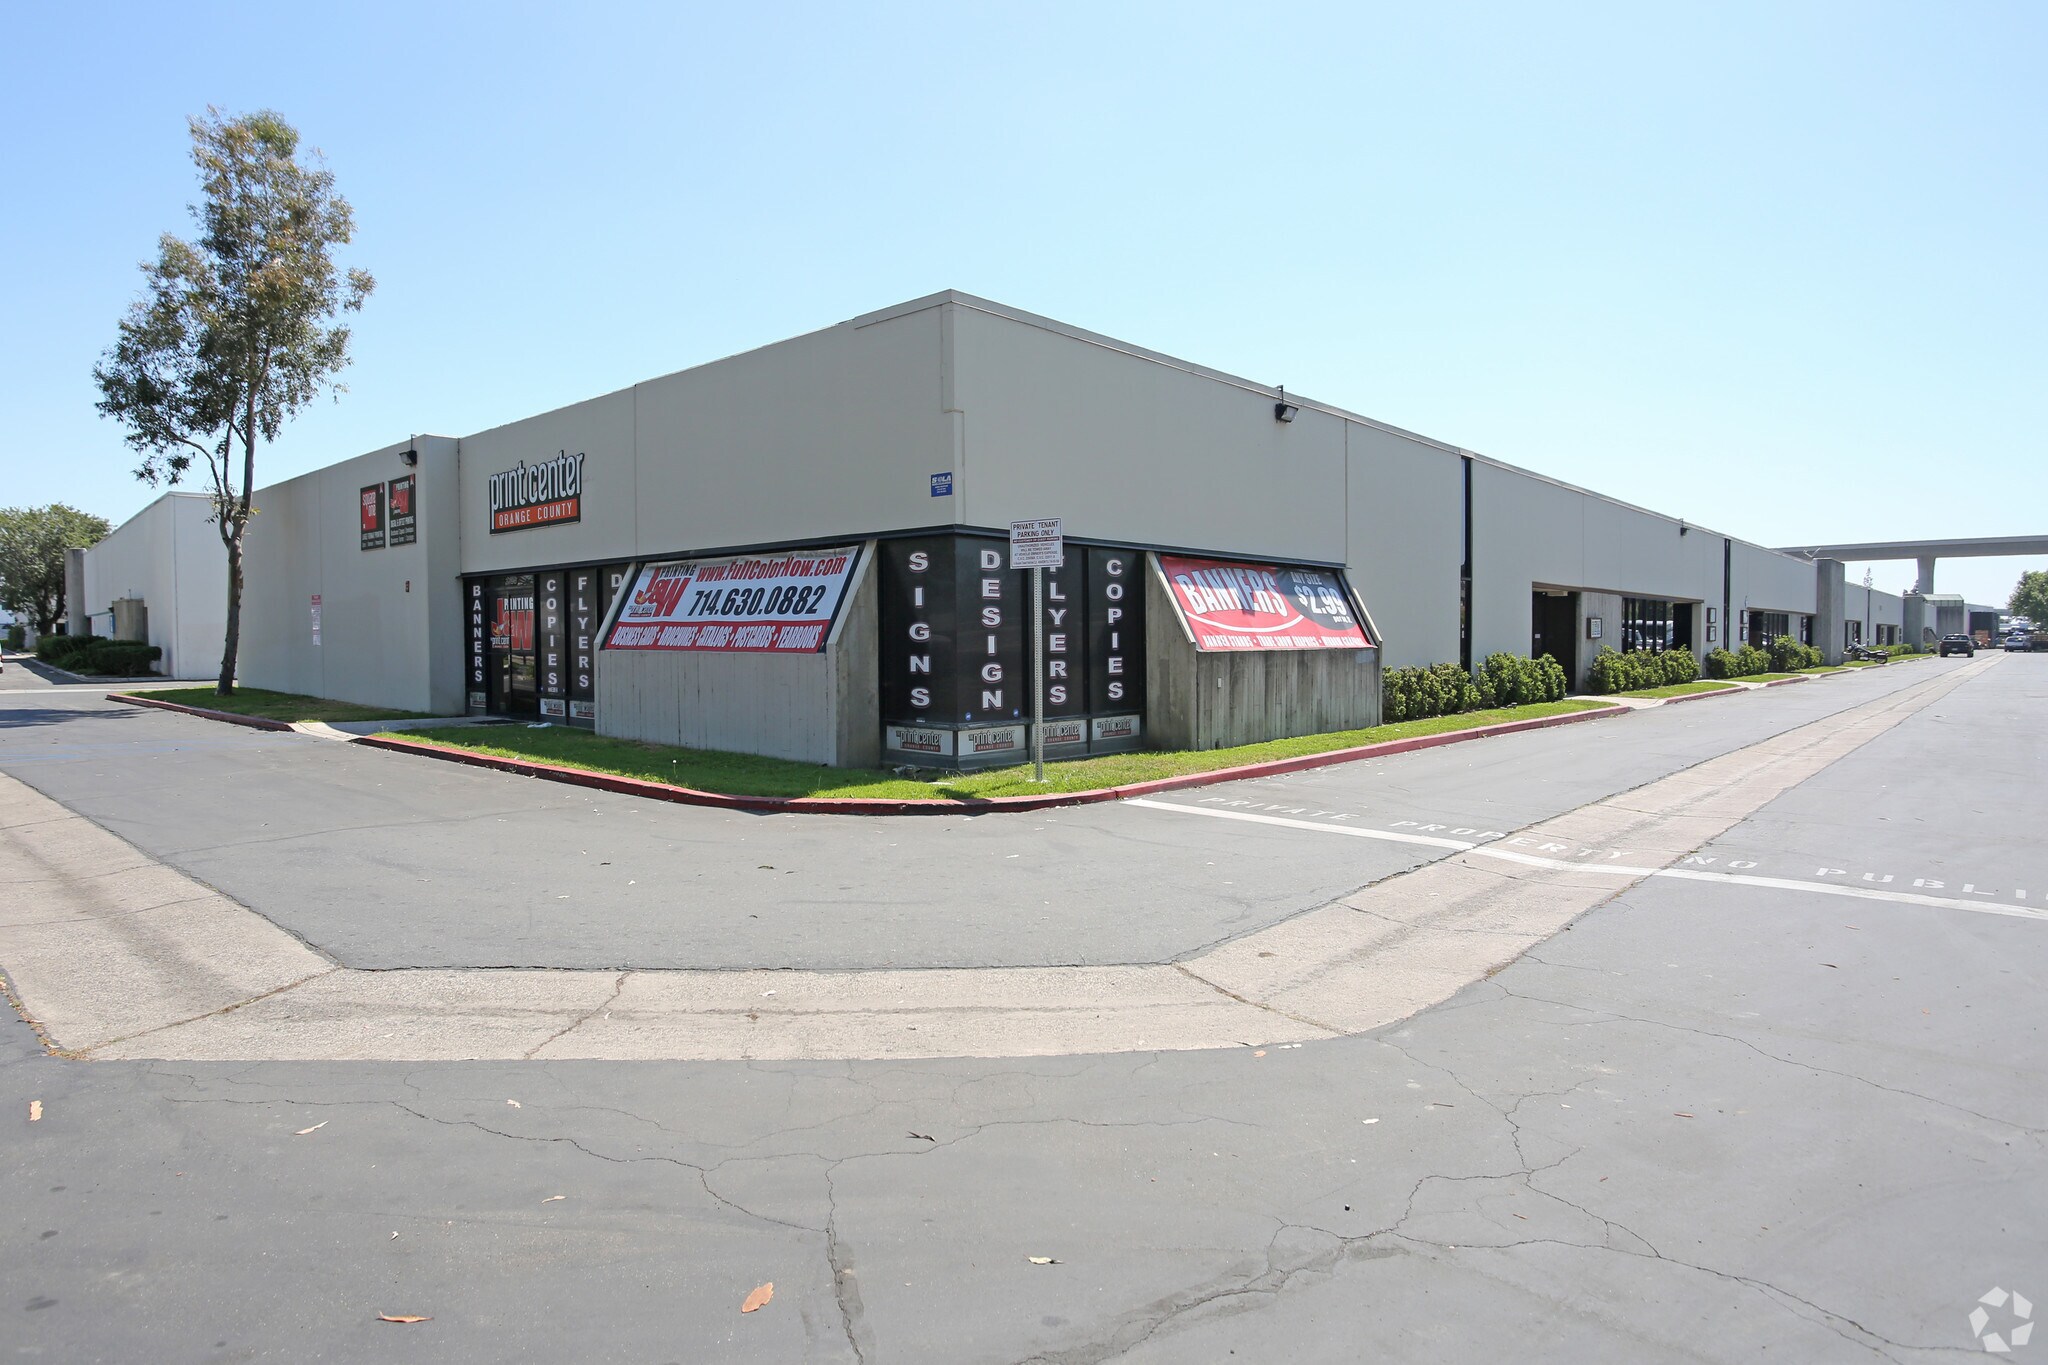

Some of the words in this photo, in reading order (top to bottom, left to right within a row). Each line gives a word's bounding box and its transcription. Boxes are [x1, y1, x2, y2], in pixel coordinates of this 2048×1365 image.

[490, 460, 527, 530] print
[527, 450, 584, 503] center
[498, 509, 532, 527] ORANGE
[537, 502, 573, 520] COUNTY
[660, 564, 697, 578] PRINTING
[695, 557, 848, 583] www.FullColorNow.com
[1174, 567, 1289, 618] BANNERS
[1290, 571, 1306, 584] ANY
[1303, 572, 1323, 585] SIZE
[687, 585, 828, 616] 714.630.0882
[1294, 585, 1347, 616] $2.99
[472, 585, 483, 682] BANNERS
[546, 579, 558, 685] COPIES
[577, 576, 589, 688] FLYERS
[729, 626, 777, 648] POSTCARDS
[775, 625, 824, 649] YEARBOOKS
[908, 552, 931, 708] SIGNS
[980, 550, 1003, 710] DESIGN
[1048, 566, 1068, 705] LYERS
[1105, 559, 1124, 700] COPIES
[900, 730, 918, 751] print
[917, 730, 942, 747] center
[973, 731, 991, 752] print
[990, 729, 1015, 745] center
[1197, 796, 1361, 821] PRIVATE
[1388, 819, 1636, 859] PROPERTY
[1682, 855, 1759, 869] NO
[1815, 867, 2048, 902] PUBLI
